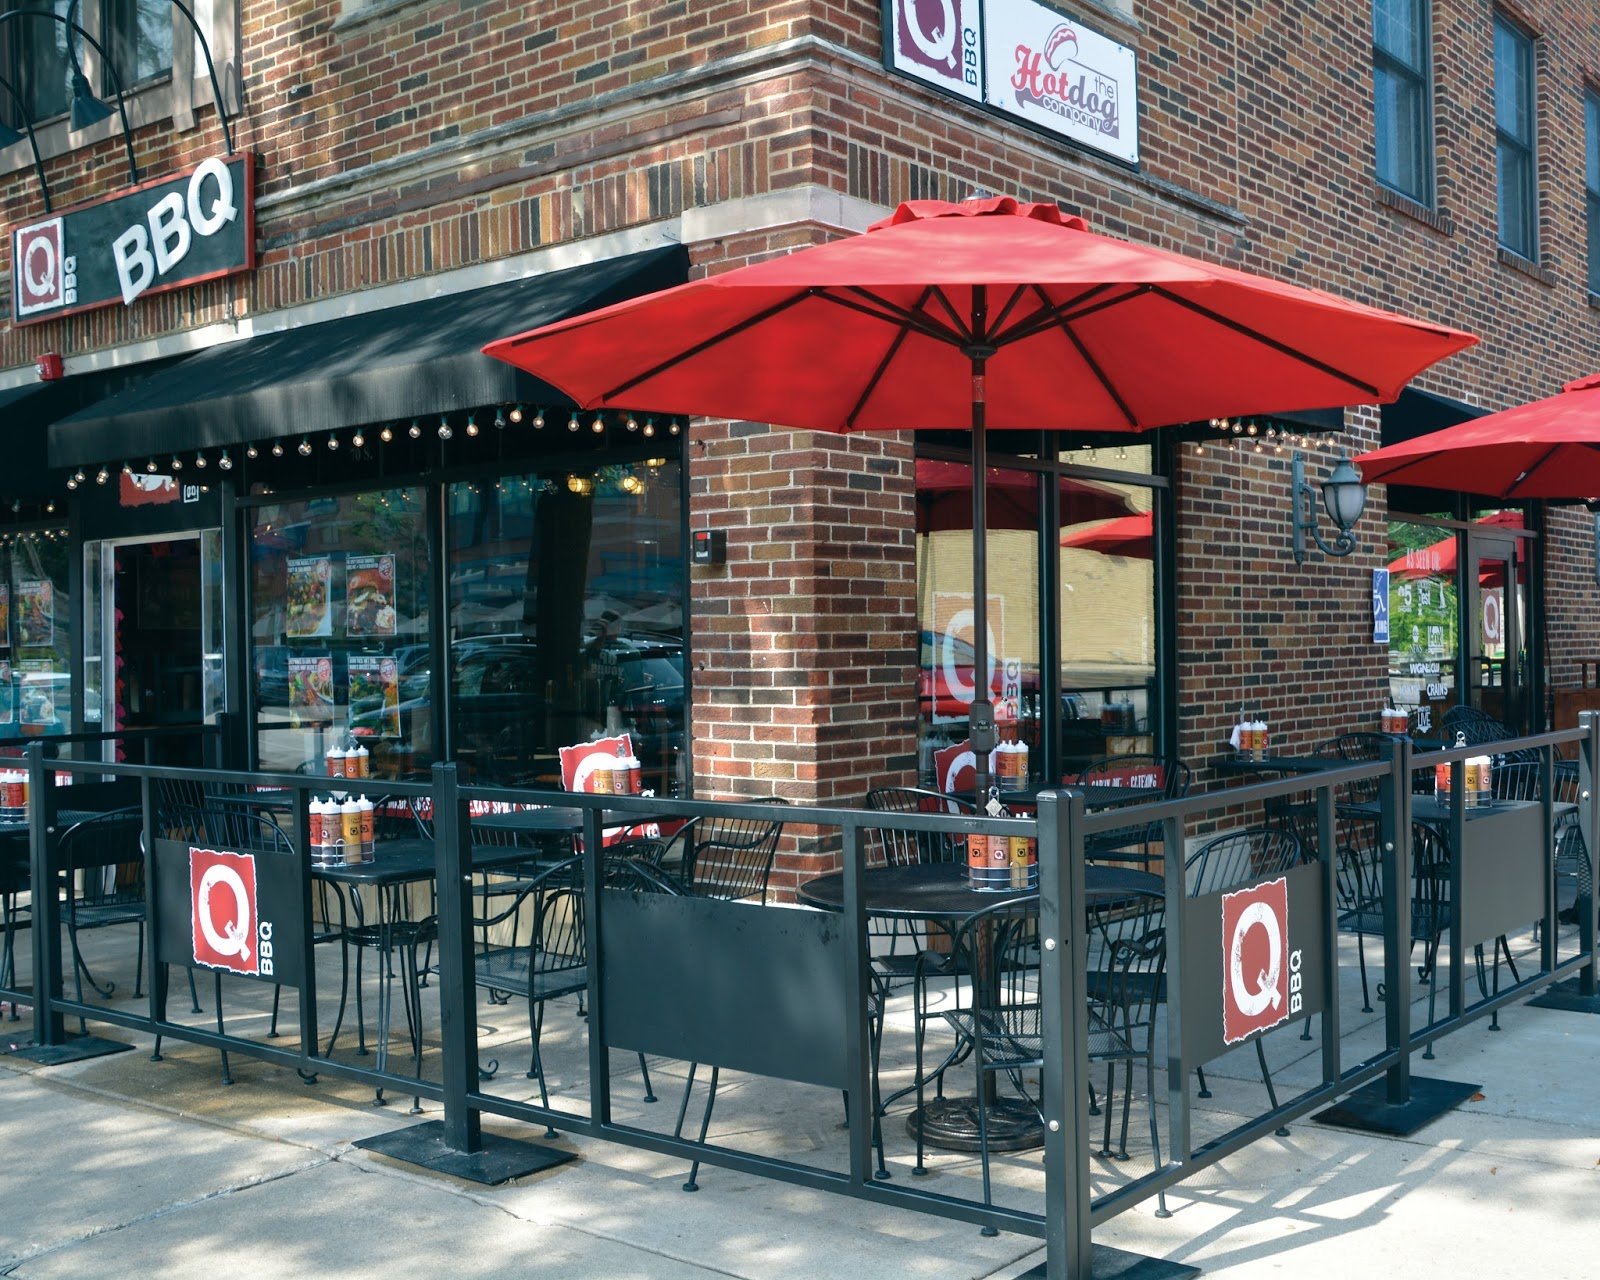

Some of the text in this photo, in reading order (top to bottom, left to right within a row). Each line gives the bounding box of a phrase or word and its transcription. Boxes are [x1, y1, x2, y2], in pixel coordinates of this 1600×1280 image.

[964, 27, 977, 87] BBQ
[1094, 75, 1115, 99] the
[1011, 44, 1119, 132] Hotdog
[1043, 96, 1102, 135] company
[112, 157, 239, 306] BBQ
[24, 236, 56, 297] Q
[65, 256, 77, 305] BBQ
[1483, 594, 1499, 640] Q
[1417, 712, 1431, 726] LIVE
[198, 864, 251, 962] Q
[259, 921, 274, 976] BBQ
[1230, 901, 1282, 1017] Q
[1290, 949, 1302, 1014] BBQ
